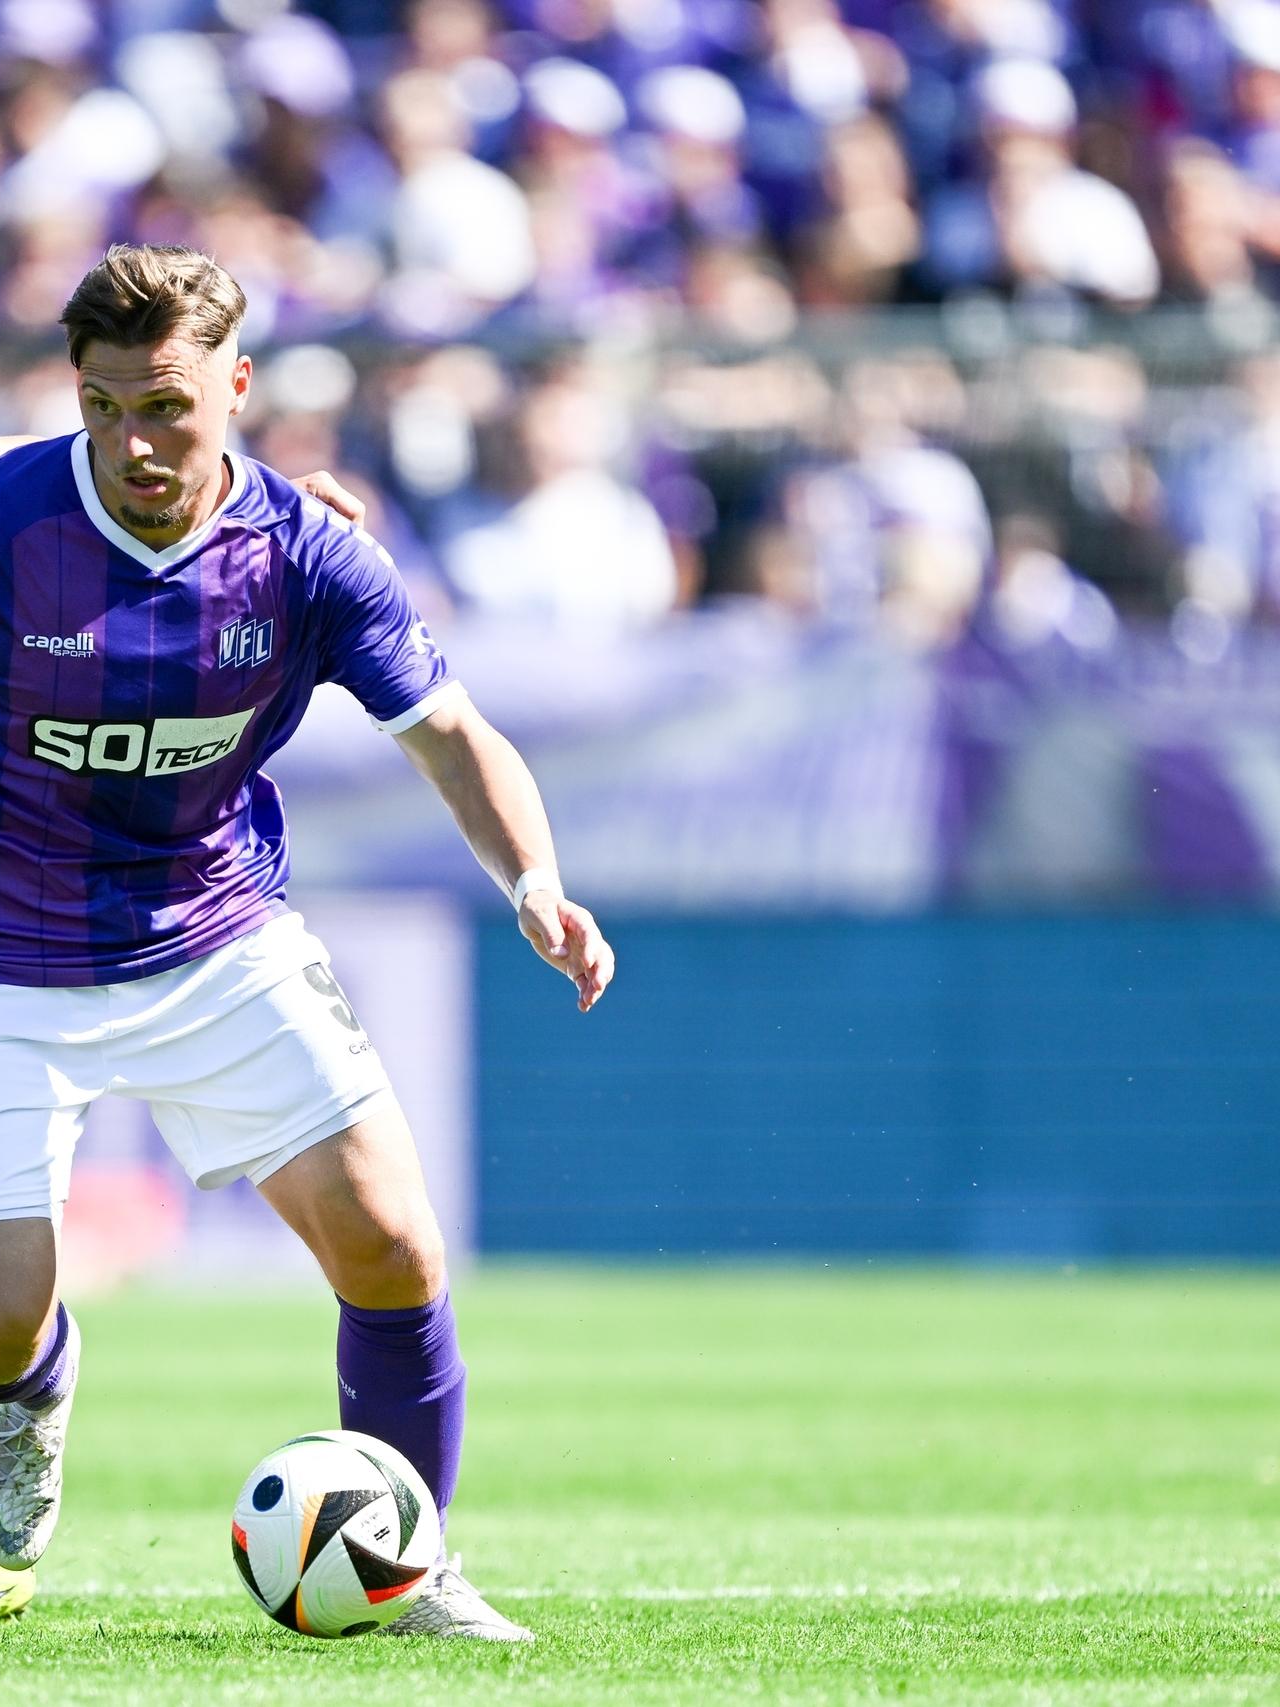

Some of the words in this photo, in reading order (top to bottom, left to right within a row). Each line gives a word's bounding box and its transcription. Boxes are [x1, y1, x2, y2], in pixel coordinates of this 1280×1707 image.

[23, 632, 94, 654] capelli
[53, 649, 94, 658] SPORT
[221, 622, 270, 664] VFL
[34, 718, 146, 773] SO
[153, 731, 239, 770] TECH
